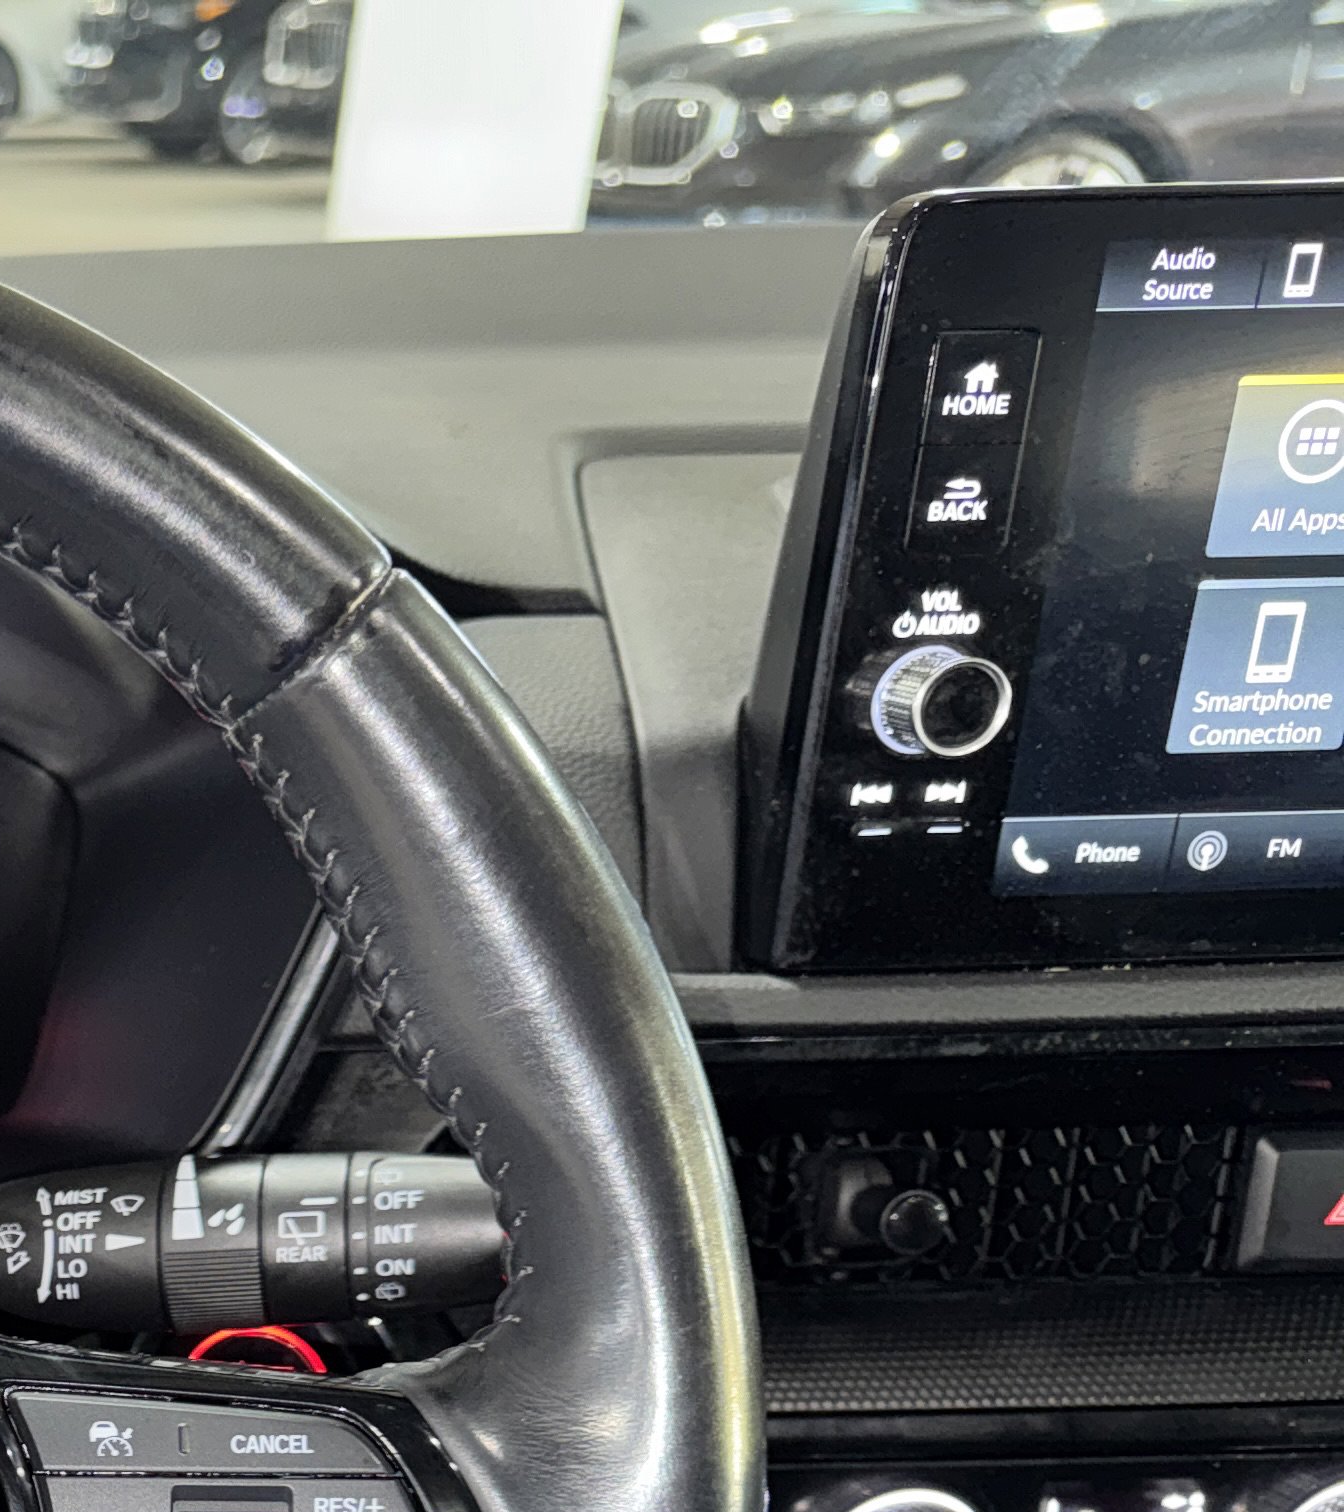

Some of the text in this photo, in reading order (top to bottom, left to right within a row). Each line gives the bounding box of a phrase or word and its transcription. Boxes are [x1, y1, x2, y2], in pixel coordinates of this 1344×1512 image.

[1151, 246, 1216, 272] Audio
[1142, 280, 1213, 302] Source
[942, 393, 1012, 417] HOME
[926, 499, 988, 522] BACK
[1251, 507, 1285, 532] All
[920, 590, 962, 613] VOL
[916, 614, 980, 636] AUDIO
[1192, 689, 1333, 716] Smartphone
[1188, 723, 1322, 747] Connection
[1075, 841, 1141, 865] Phone
[1267, 838, 1302, 859] FM
[54, 1186, 108, 1206] MIST
[373, 1189, 424, 1212] OFF
[57, 1211, 102, 1232] OFF
[58, 1234, 96, 1254] INT
[374, 1224, 416, 1245] INT
[275, 1245, 327, 1264] REAR
[57, 1259, 87, 1280] LO
[375, 1258, 415, 1278] ON
[56, 1283, 80, 1300] HI
[230, 1434, 314, 1454] CANCEL
